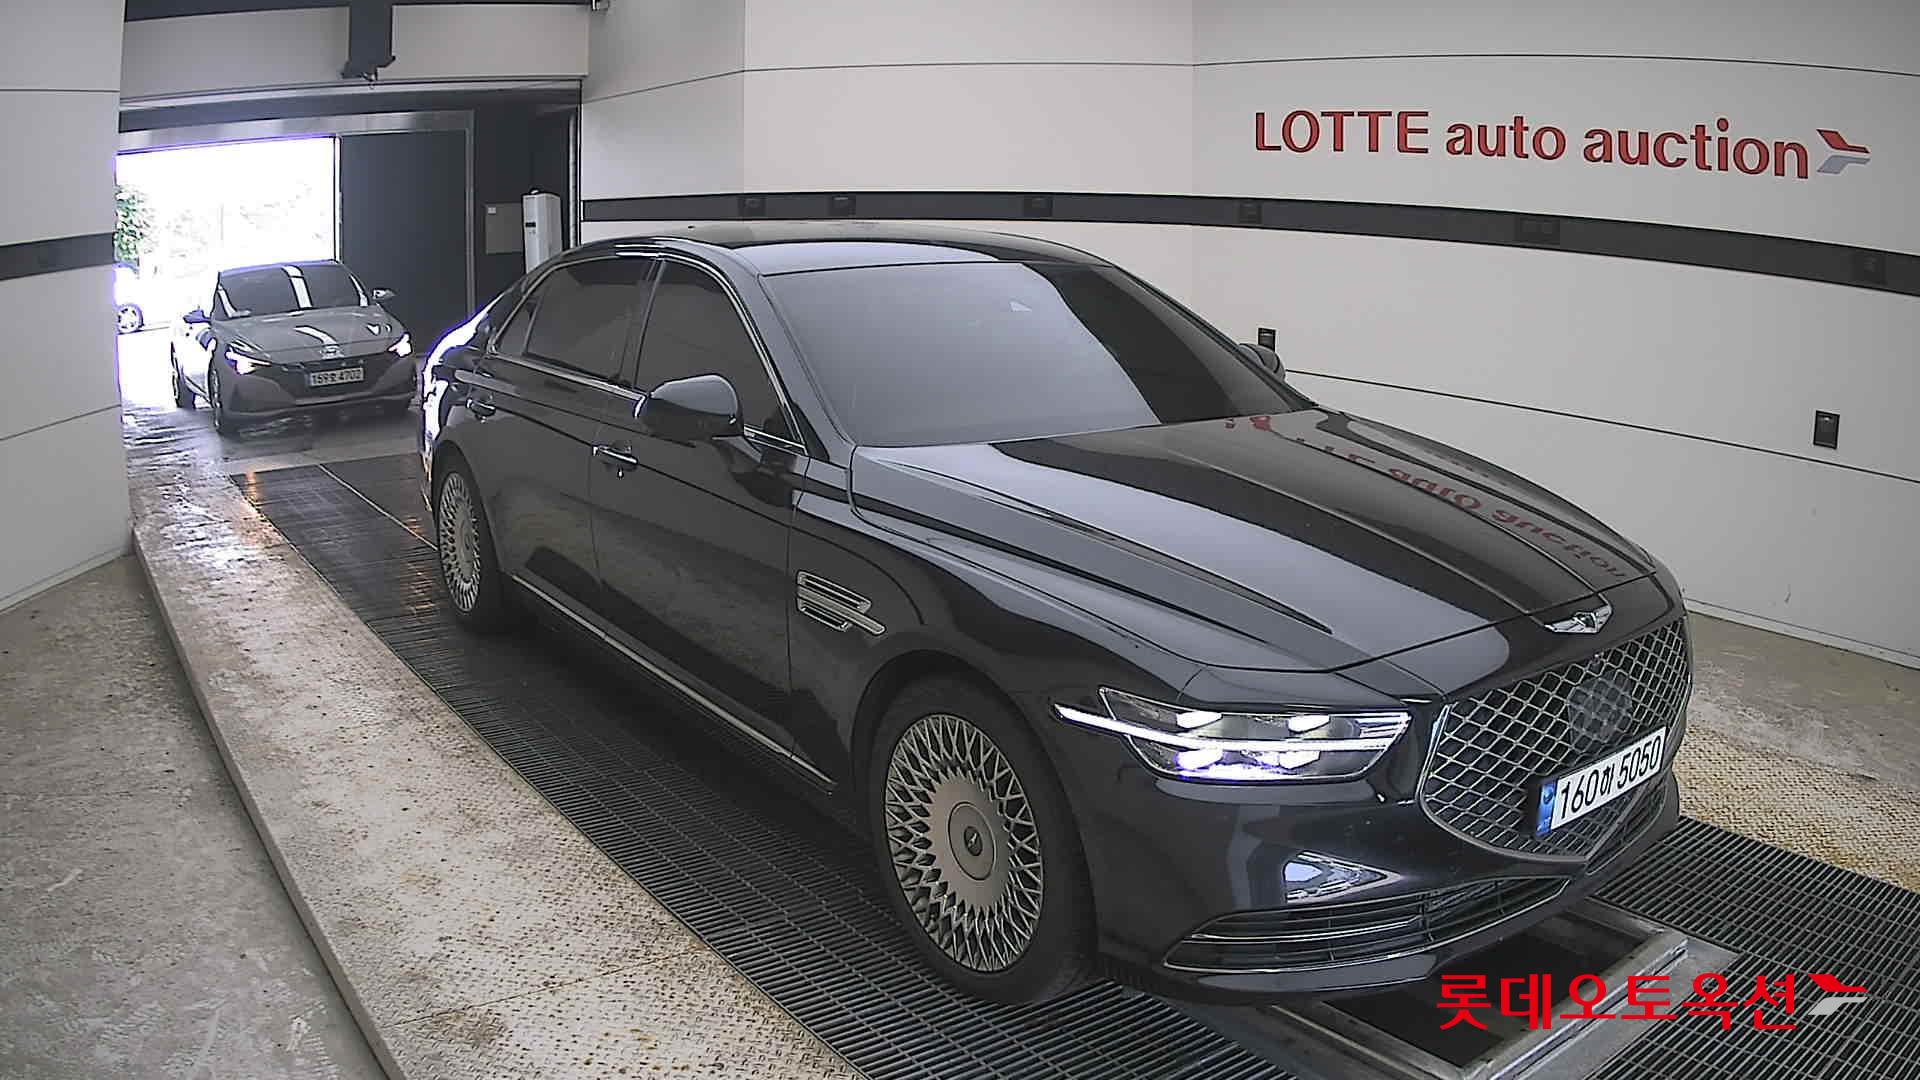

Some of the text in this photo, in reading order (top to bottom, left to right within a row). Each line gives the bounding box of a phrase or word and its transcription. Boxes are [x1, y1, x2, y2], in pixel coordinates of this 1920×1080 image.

[1255, 110, 1809, 179] LOTTE auto auction
[1616, 735, 1662, 790] 5050
